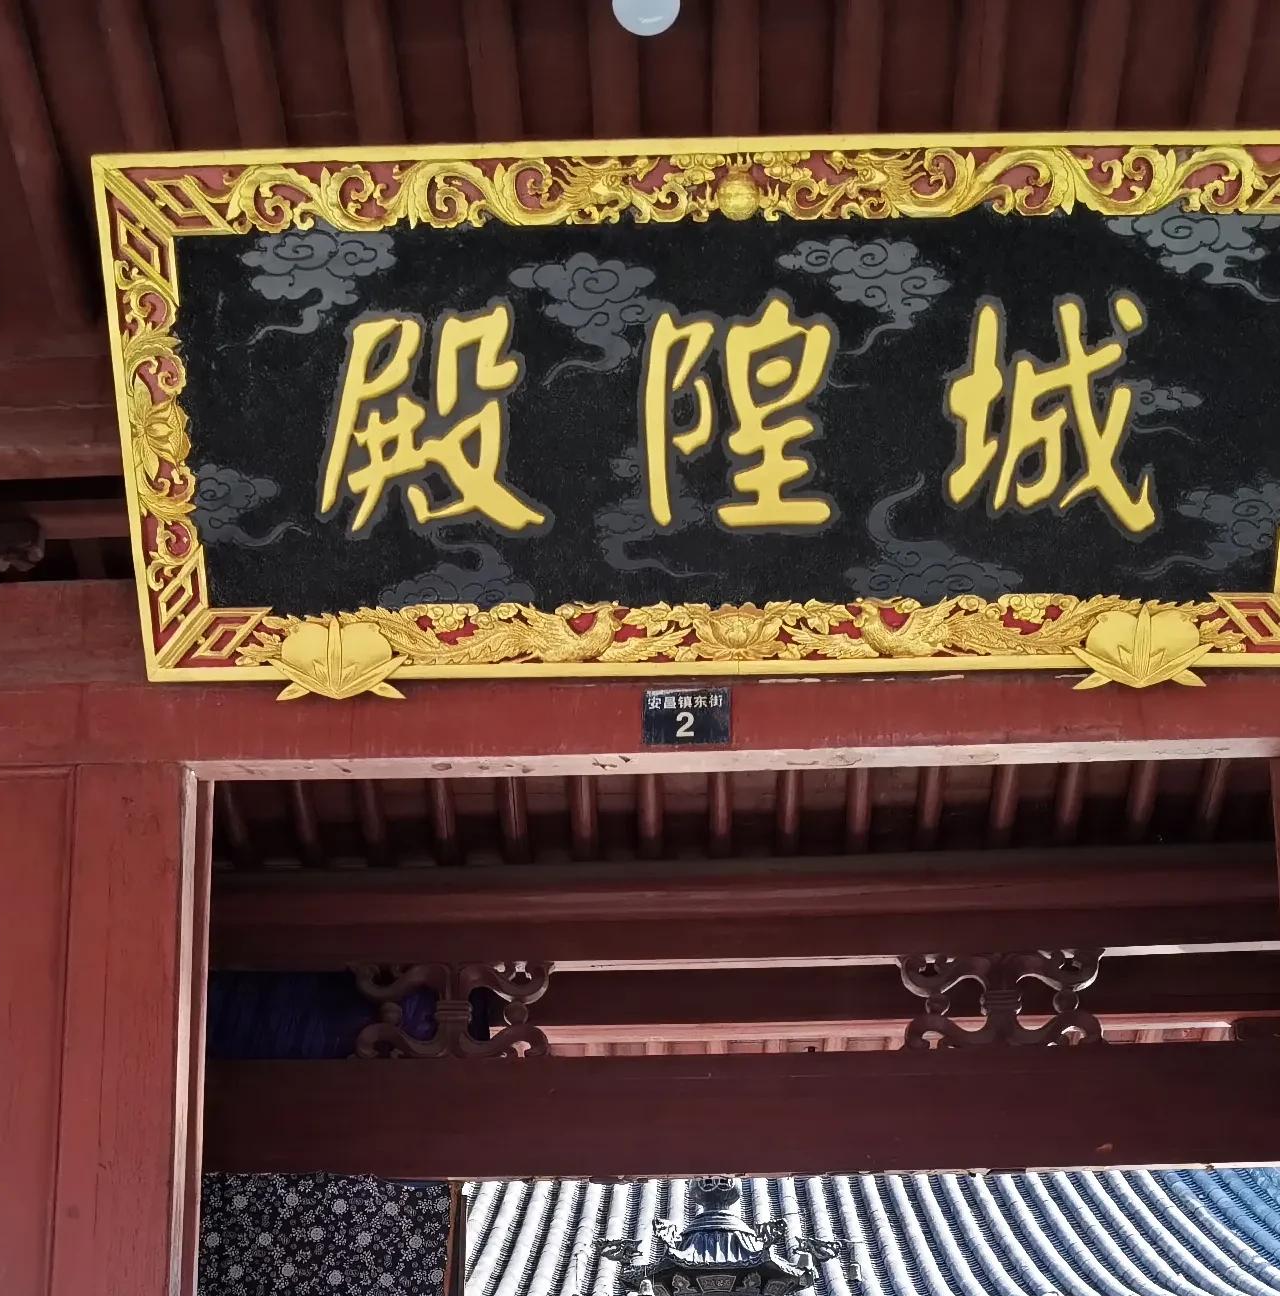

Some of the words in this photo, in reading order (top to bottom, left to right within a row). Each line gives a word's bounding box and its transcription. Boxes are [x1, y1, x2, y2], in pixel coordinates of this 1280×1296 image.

[647, 694, 723, 710] 安昌镇东街
[676, 711, 695, 738] 2
